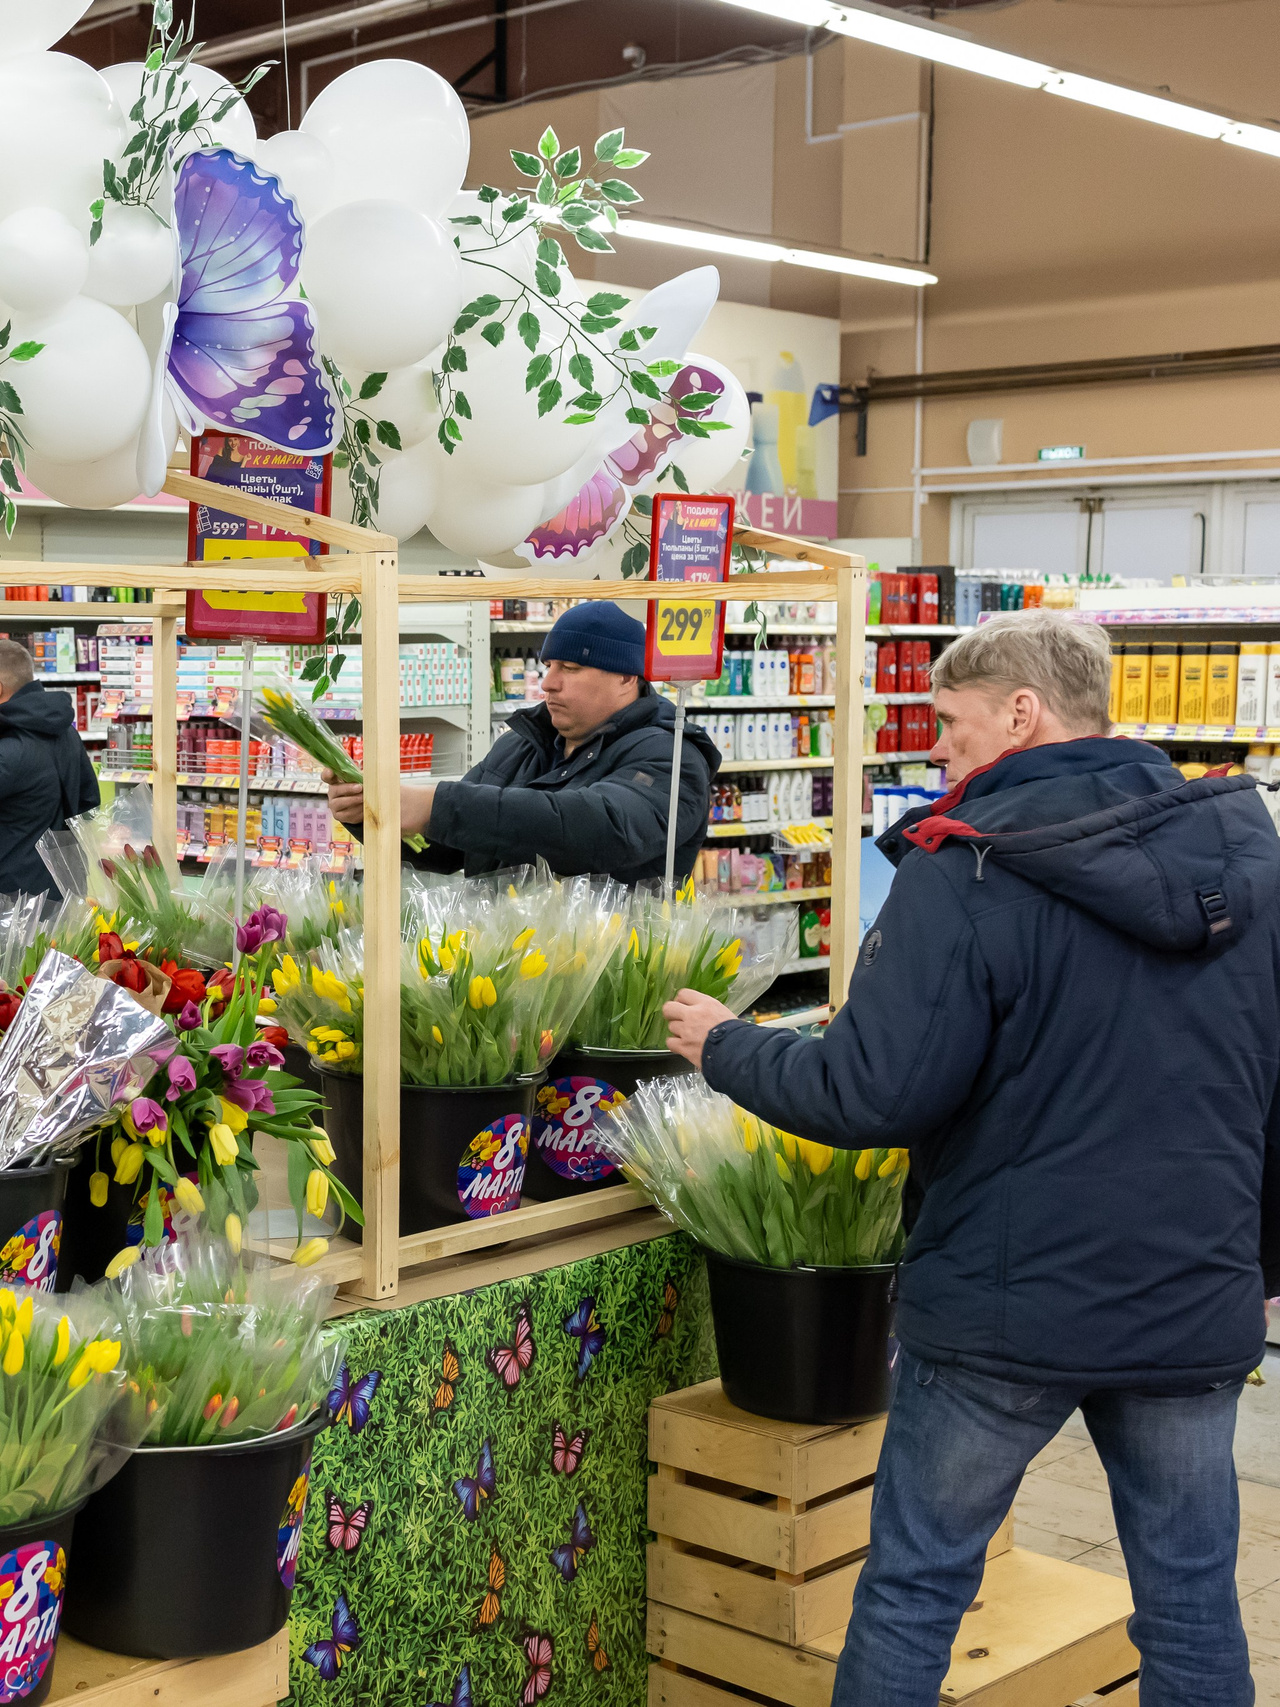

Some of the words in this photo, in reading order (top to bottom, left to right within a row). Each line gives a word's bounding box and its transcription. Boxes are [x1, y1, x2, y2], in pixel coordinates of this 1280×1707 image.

[253, 455, 261, 465] К
[263, 455, 270, 464] 8
[272, 455, 304, 465] МАРТА
[240, 474, 277, 484] Цветы
[271, 484, 304, 496] (9шт),
[686, 507, 719, 516] ПОДАРКИ
[212, 522, 239, 536] 599
[682, 535, 703, 544] Цветы
[662, 543, 694, 552] Тюльпаны
[695, 554, 710, 563] упак.
[660, 607, 703, 641] 299
[703, 609, 711, 618] 99
[563, 1085, 604, 1127] 8
[493, 1122, 523, 1170] 8
[462, 1165, 525, 1200] МАРТА
[27, 1220, 58, 1280] 8
[3, 1550, 51, 1624] 8
